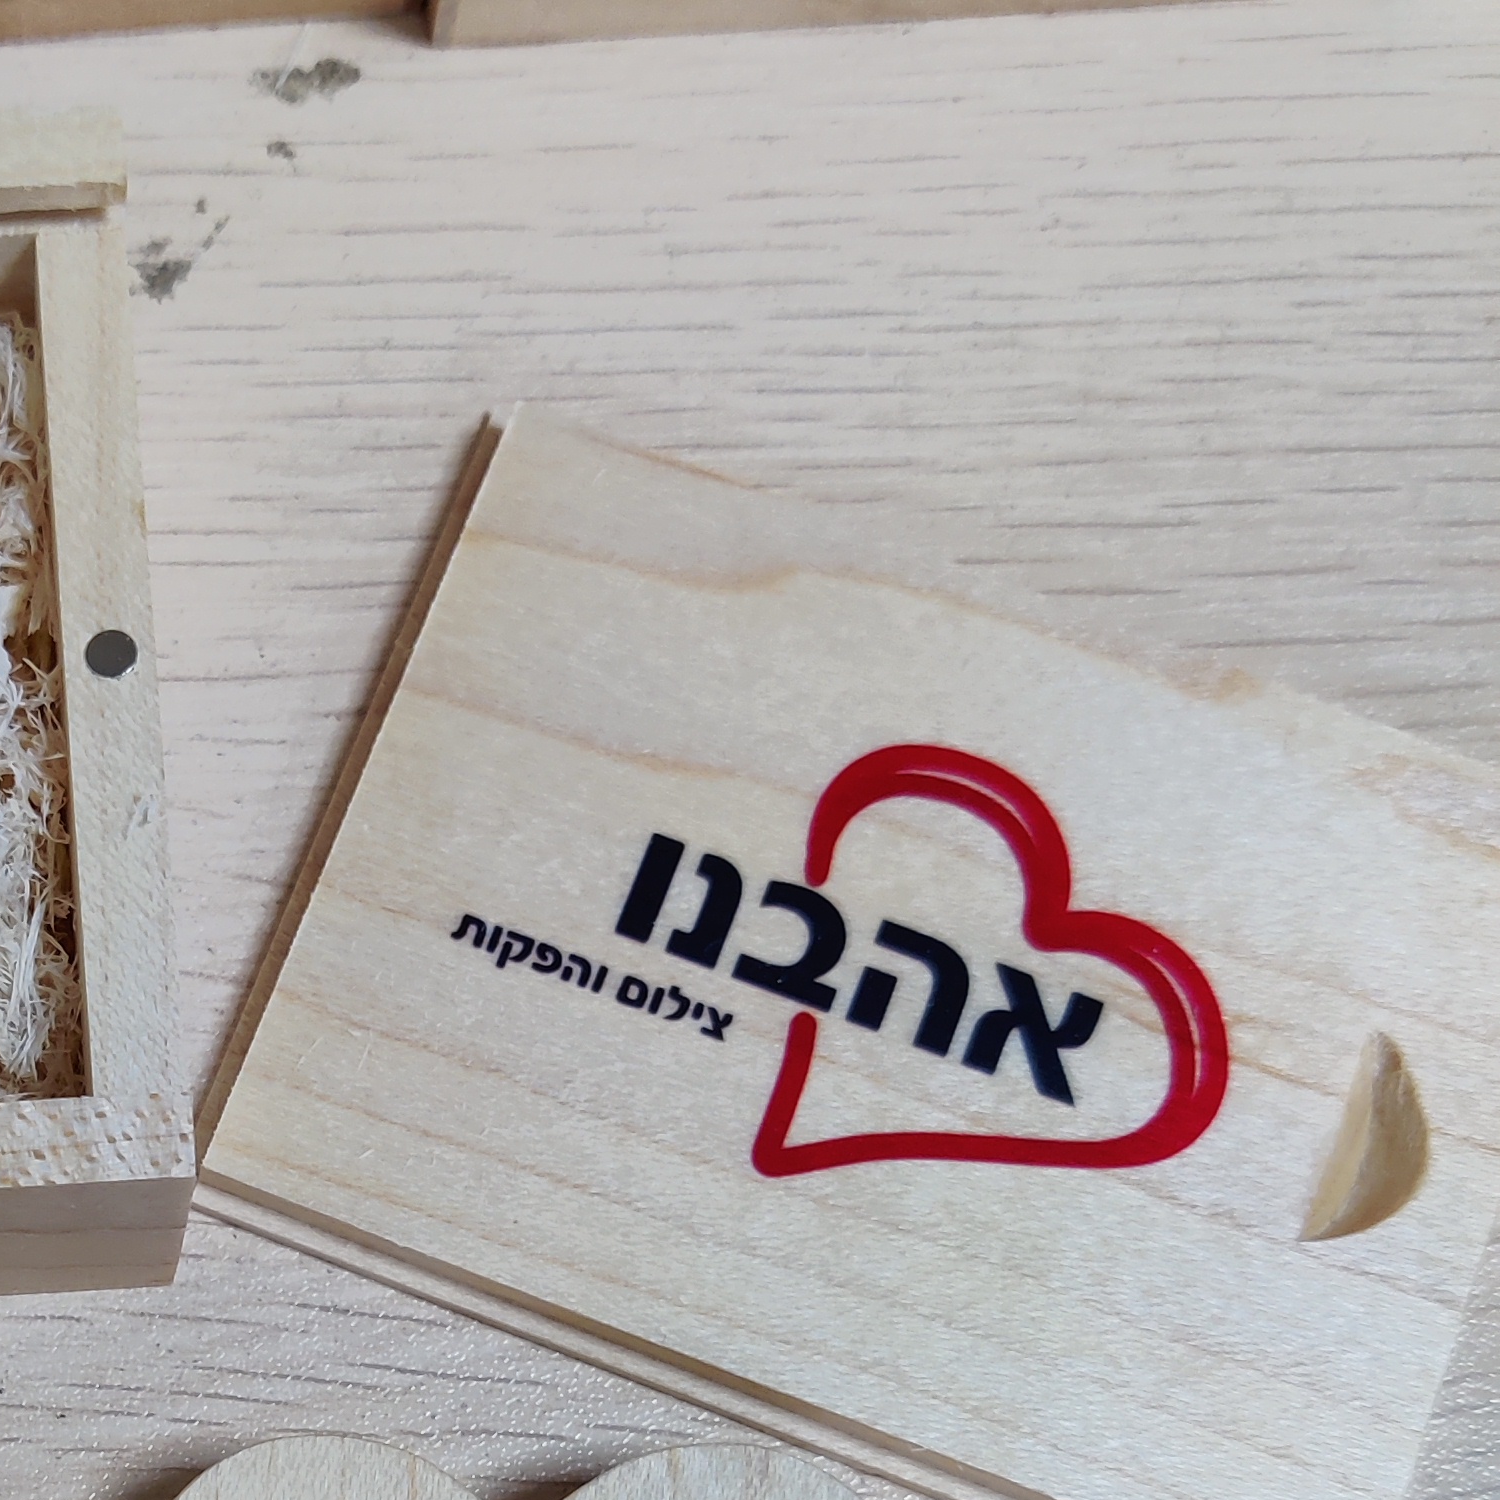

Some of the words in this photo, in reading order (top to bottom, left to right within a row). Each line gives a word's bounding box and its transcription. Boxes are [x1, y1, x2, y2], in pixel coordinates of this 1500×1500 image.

[451, 912, 607, 994] והפקות
[614, 832, 1104, 1106] אהבנו
[616, 976, 733, 1042] צילום
